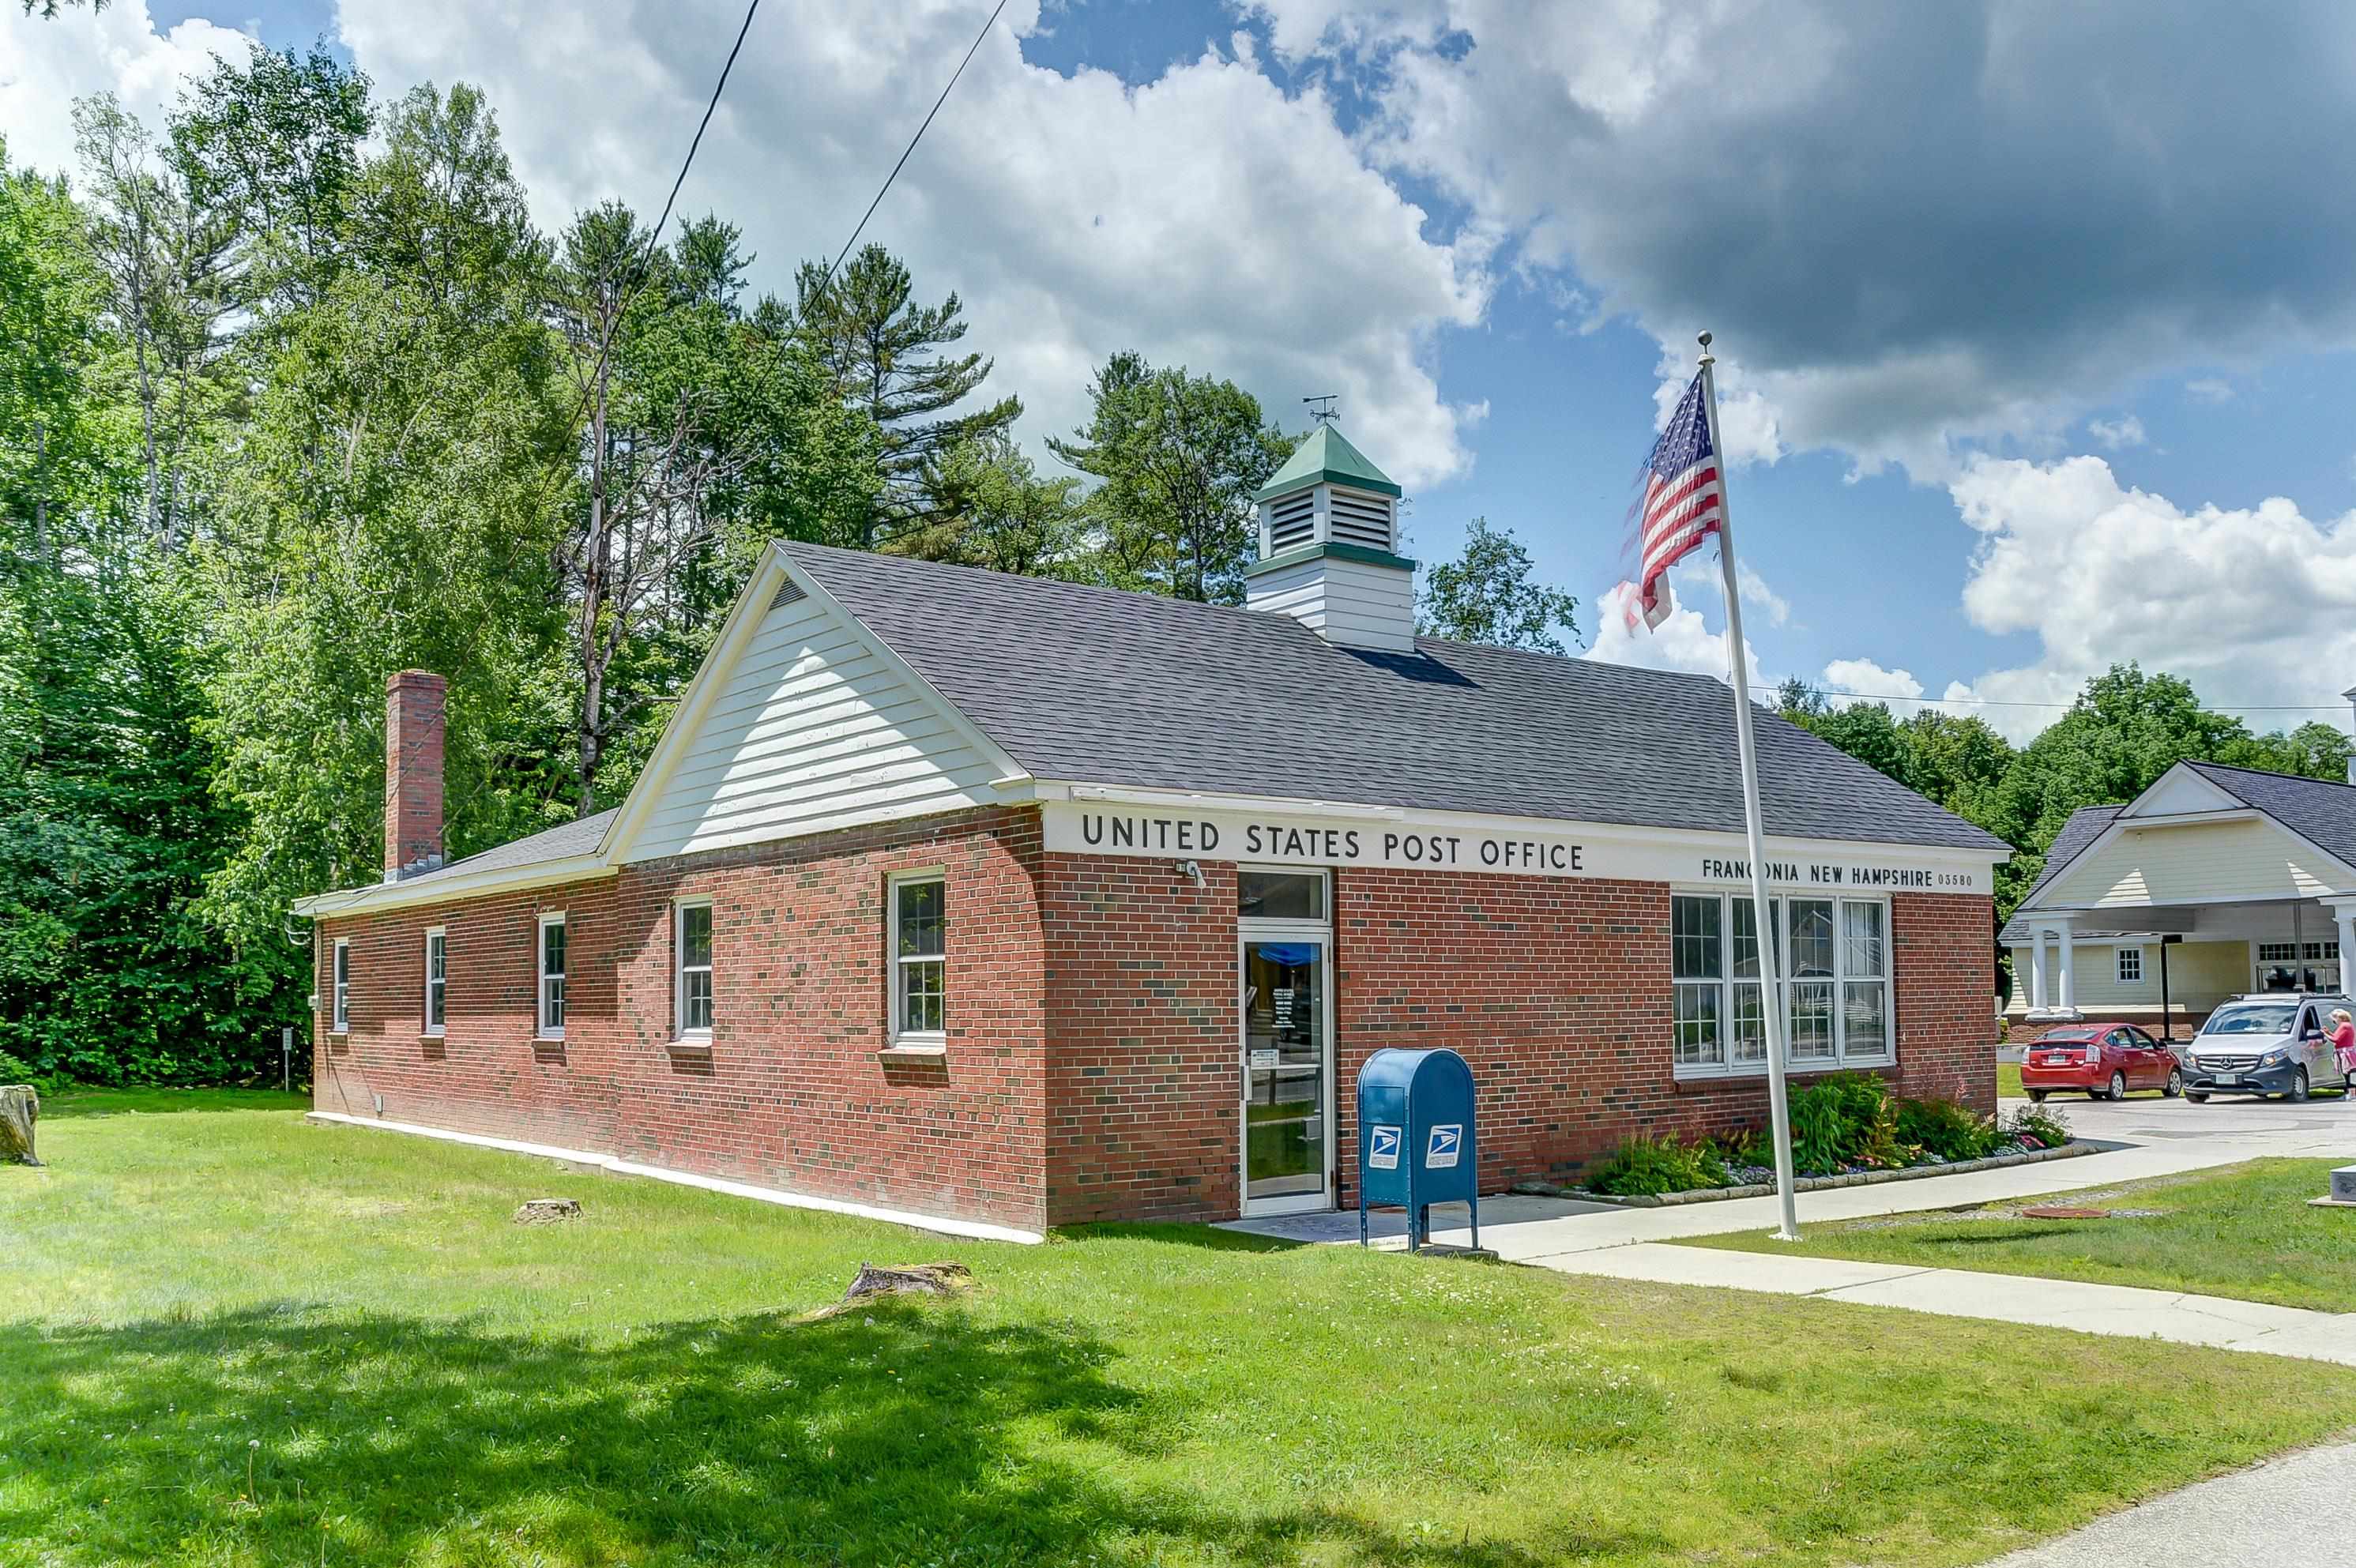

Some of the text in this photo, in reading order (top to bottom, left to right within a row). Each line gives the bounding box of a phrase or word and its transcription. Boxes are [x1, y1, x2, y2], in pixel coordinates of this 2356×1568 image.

[1082, 814, 1584, 870] UNITED STATES POST OFFICE
[1810, 865, 1842, 883] NEW
[1852, 867, 1933, 887] HAMPSHIRE
[1938, 873, 1972, 886] 03580
